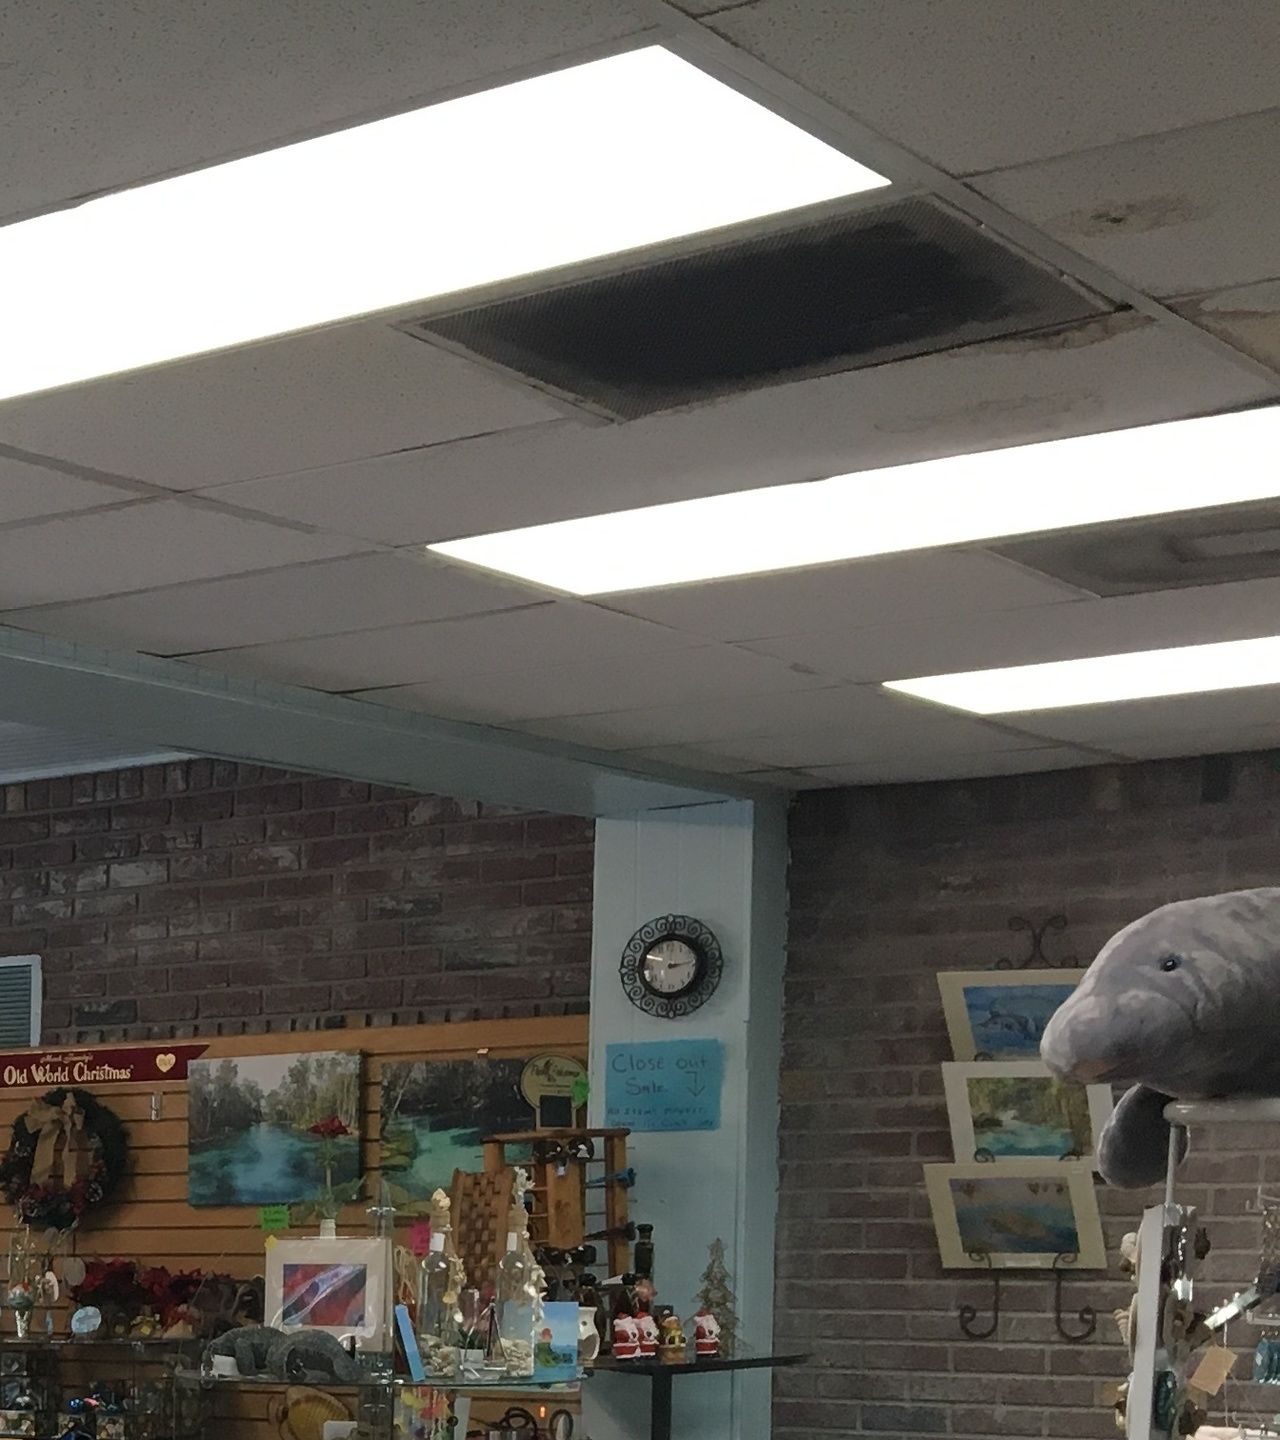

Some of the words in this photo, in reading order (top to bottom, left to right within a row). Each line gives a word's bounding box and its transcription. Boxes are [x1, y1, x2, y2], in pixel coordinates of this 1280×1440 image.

[612, 1053, 664, 1073] Close
[3, 1065, 28, 1085] Old
[31, 1064, 70, 1083] World
